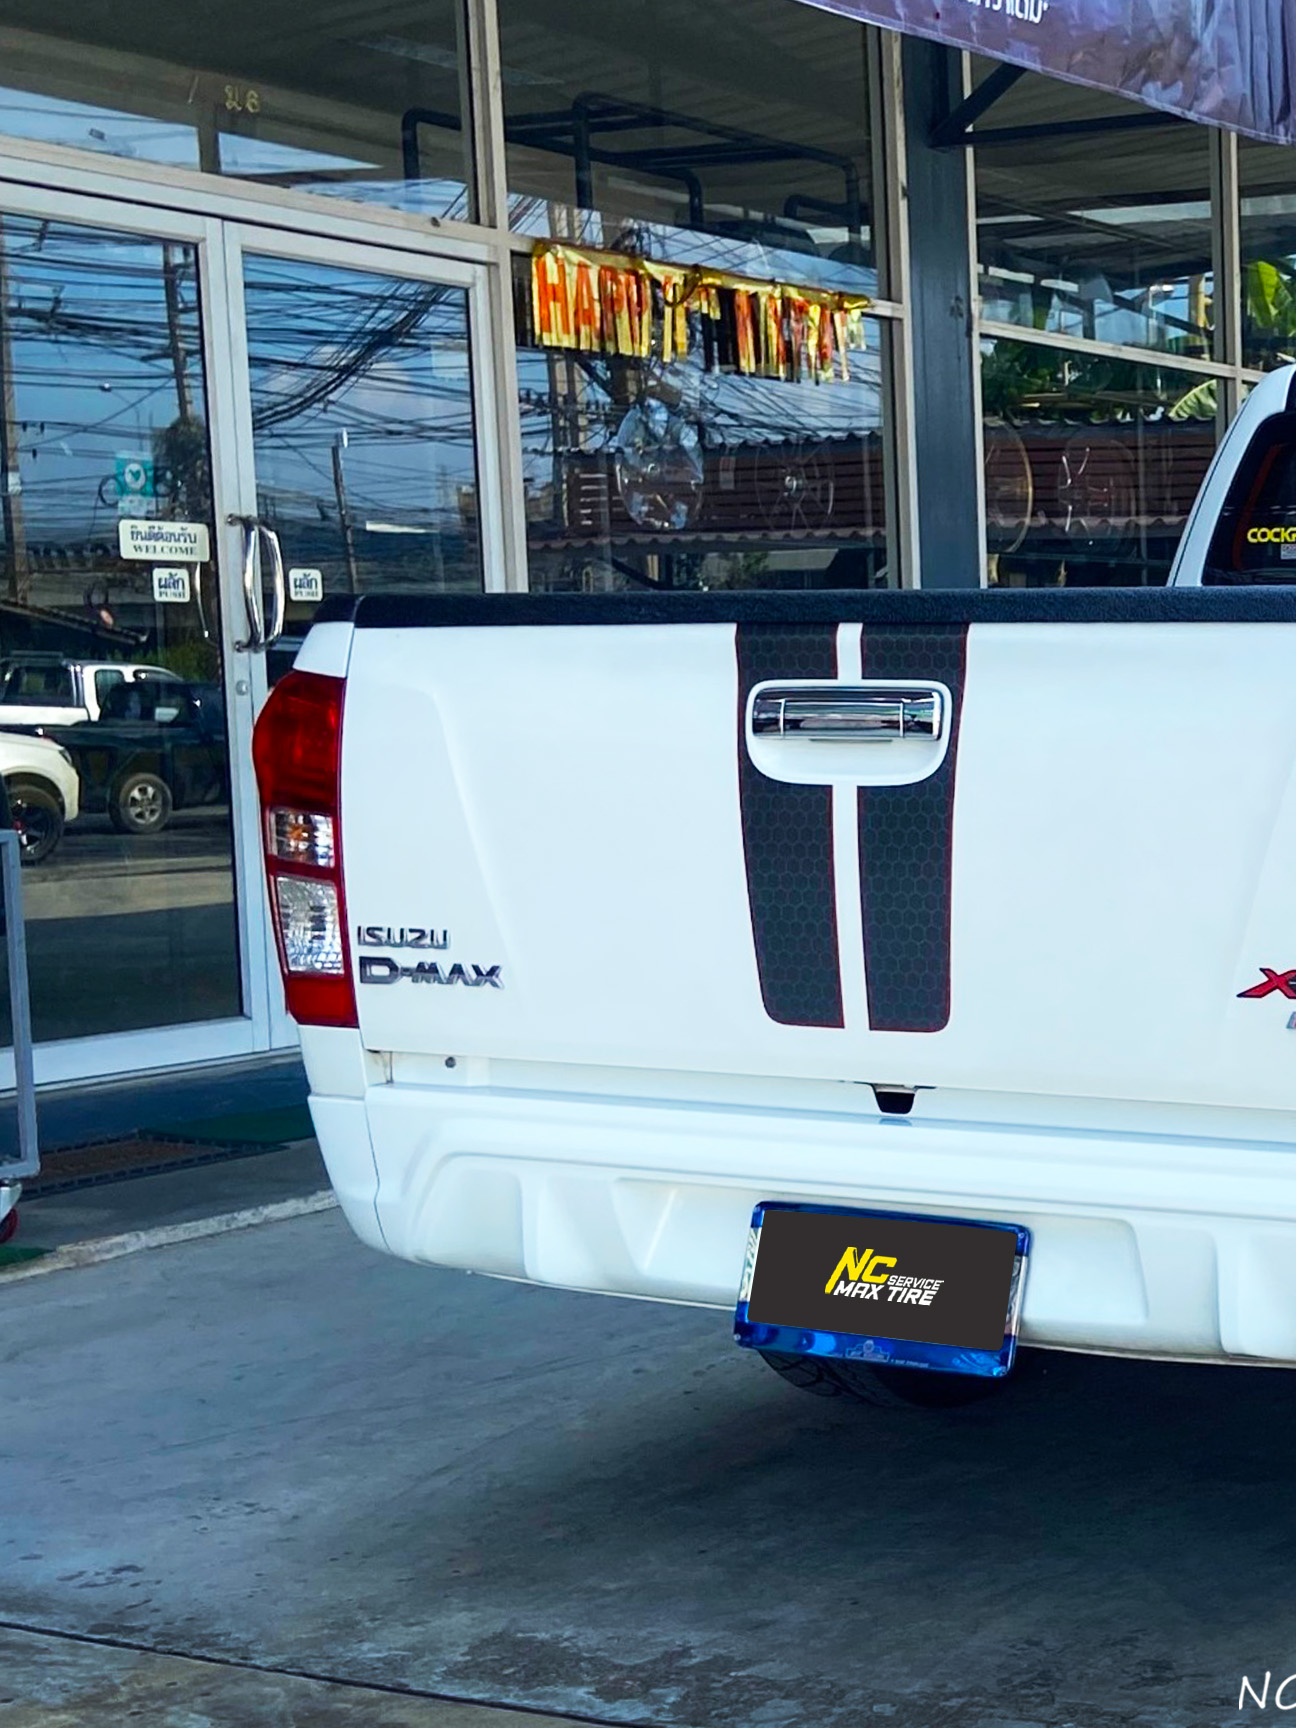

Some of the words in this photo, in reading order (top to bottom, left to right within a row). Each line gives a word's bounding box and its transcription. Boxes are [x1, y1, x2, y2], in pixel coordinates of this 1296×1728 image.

[132, 544, 198, 556] WELCOME
[357, 926, 448, 950] ISUZU
[358, 955, 504, 989] D-MAX
